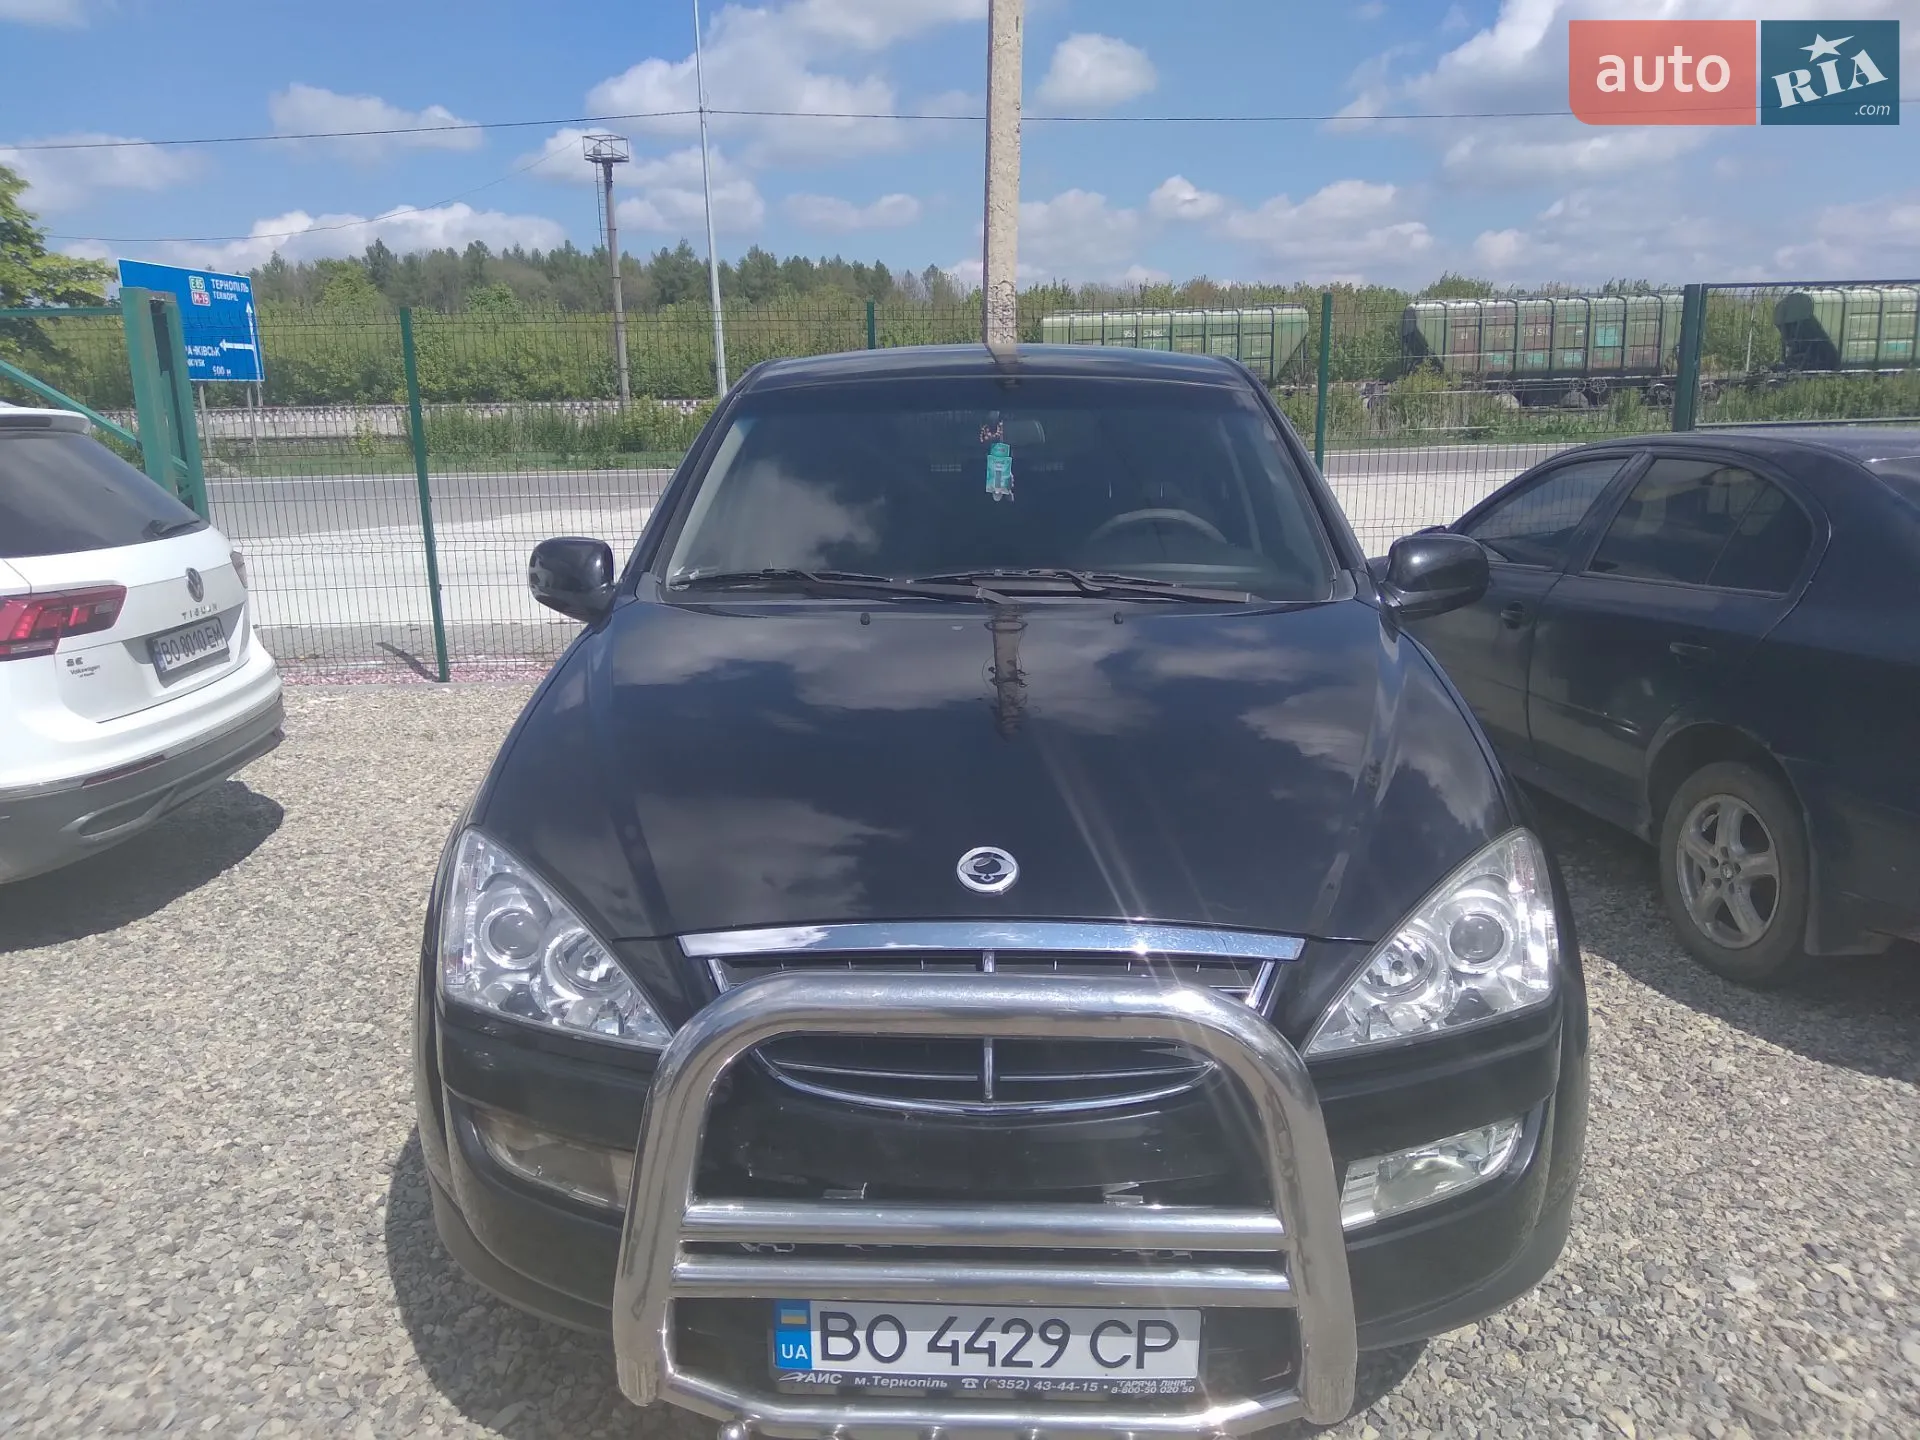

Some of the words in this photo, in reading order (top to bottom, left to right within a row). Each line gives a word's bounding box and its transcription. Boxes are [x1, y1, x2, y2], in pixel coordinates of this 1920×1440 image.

[211, 279, 249, 293] ТЕРНОПІЛЬ
[161, 639, 181, 665] BO
[179, 630, 207, 658] 8010
[205, 623, 226, 649] EM
[819, 1311, 907, 1364] BO
[927, 1315, 1071, 1369] 4429
[1089, 1319, 1180, 1370] CP
[781, 1343, 809, 1360] UA
[803, 1373, 843, 1385] АИС
[1033, 1380, 1099, 1392] 43-44-15
